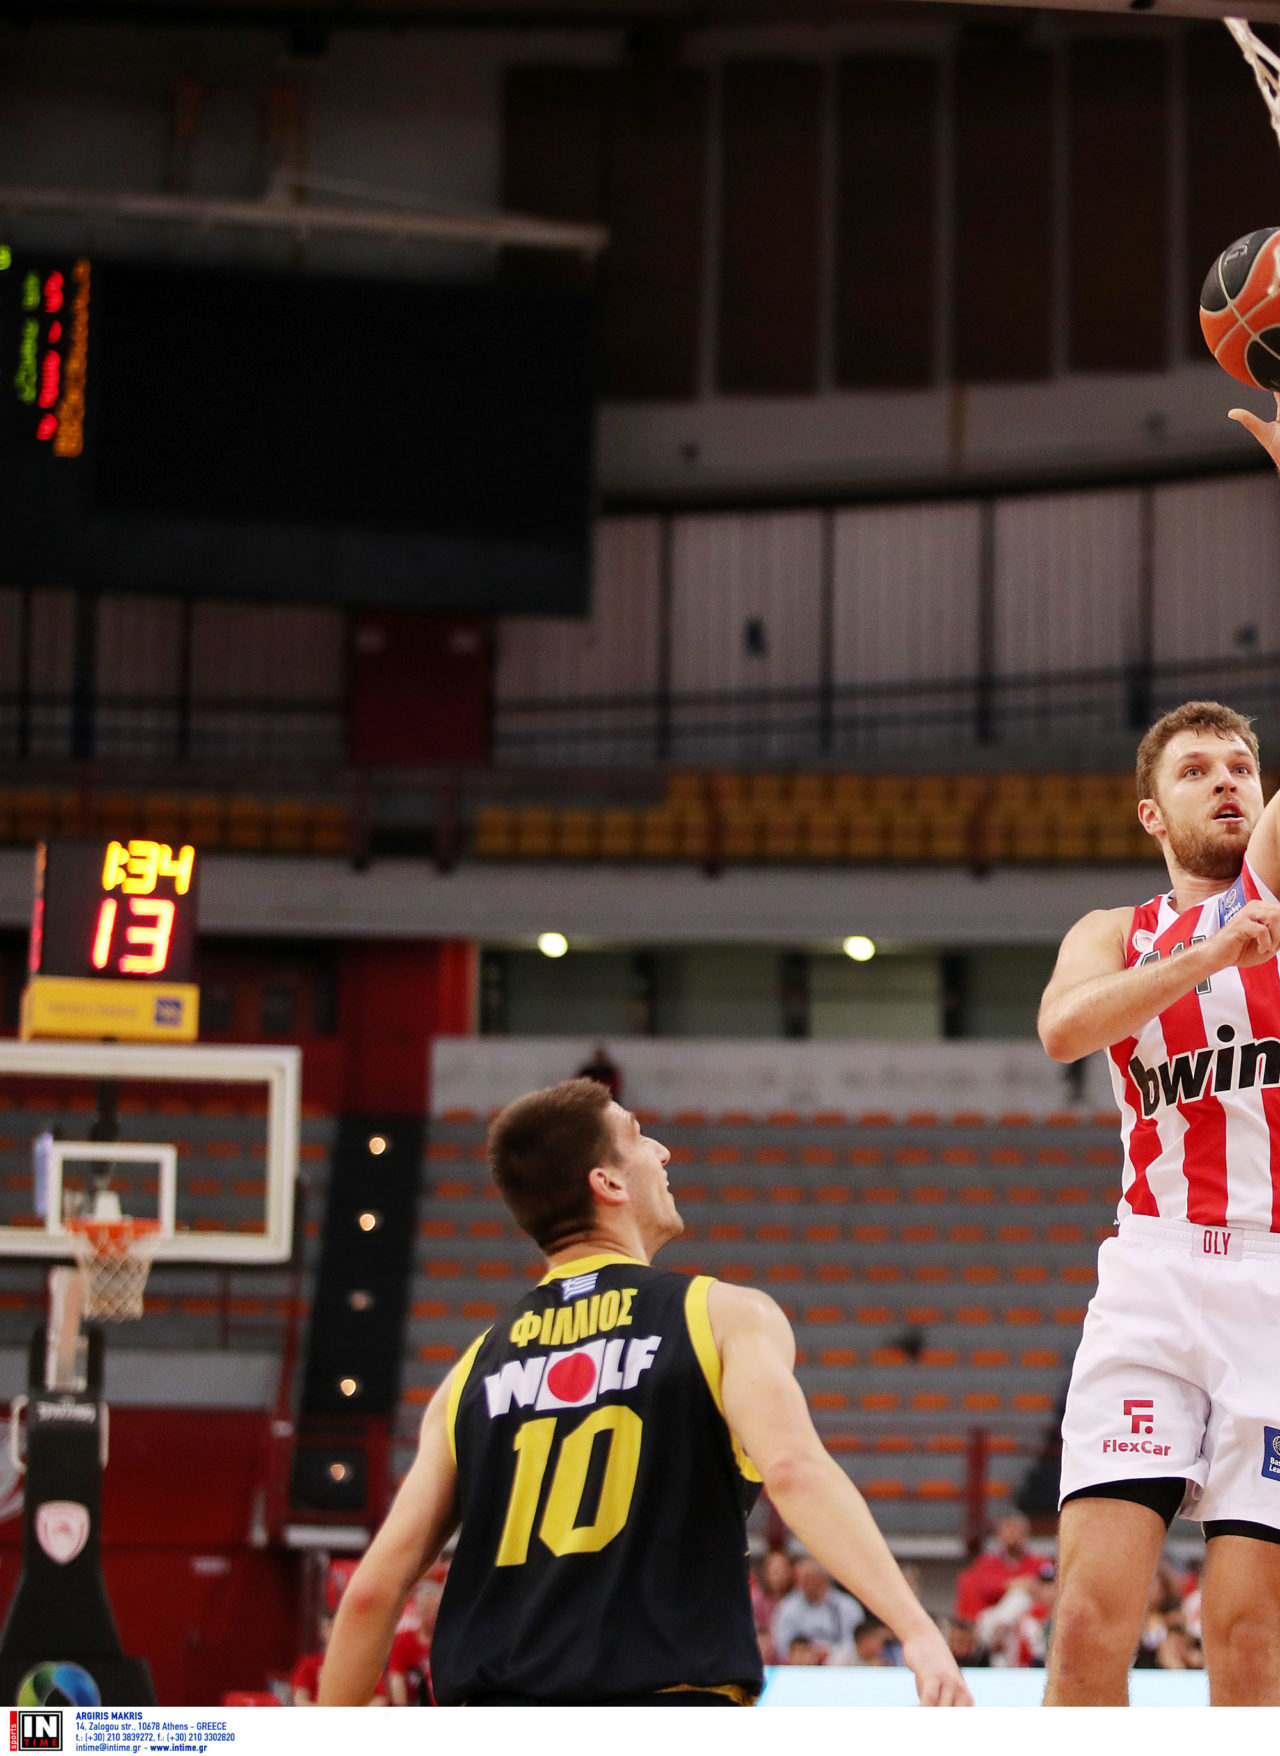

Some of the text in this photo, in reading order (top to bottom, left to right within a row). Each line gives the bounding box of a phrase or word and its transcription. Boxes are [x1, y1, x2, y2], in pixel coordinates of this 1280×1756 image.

[102, 840, 196, 895] 1:34
[92, 897, 176, 974] 13
[1203, 1229, 1231, 1256] OLY
[509, 1288, 639, 1348] ΦΙΛΛΙΟΣ
[484, 1335, 663, 1419] WOLF
[1102, 1439, 1172, 1457] FlexCar
[495, 1404, 644, 1567] 10
